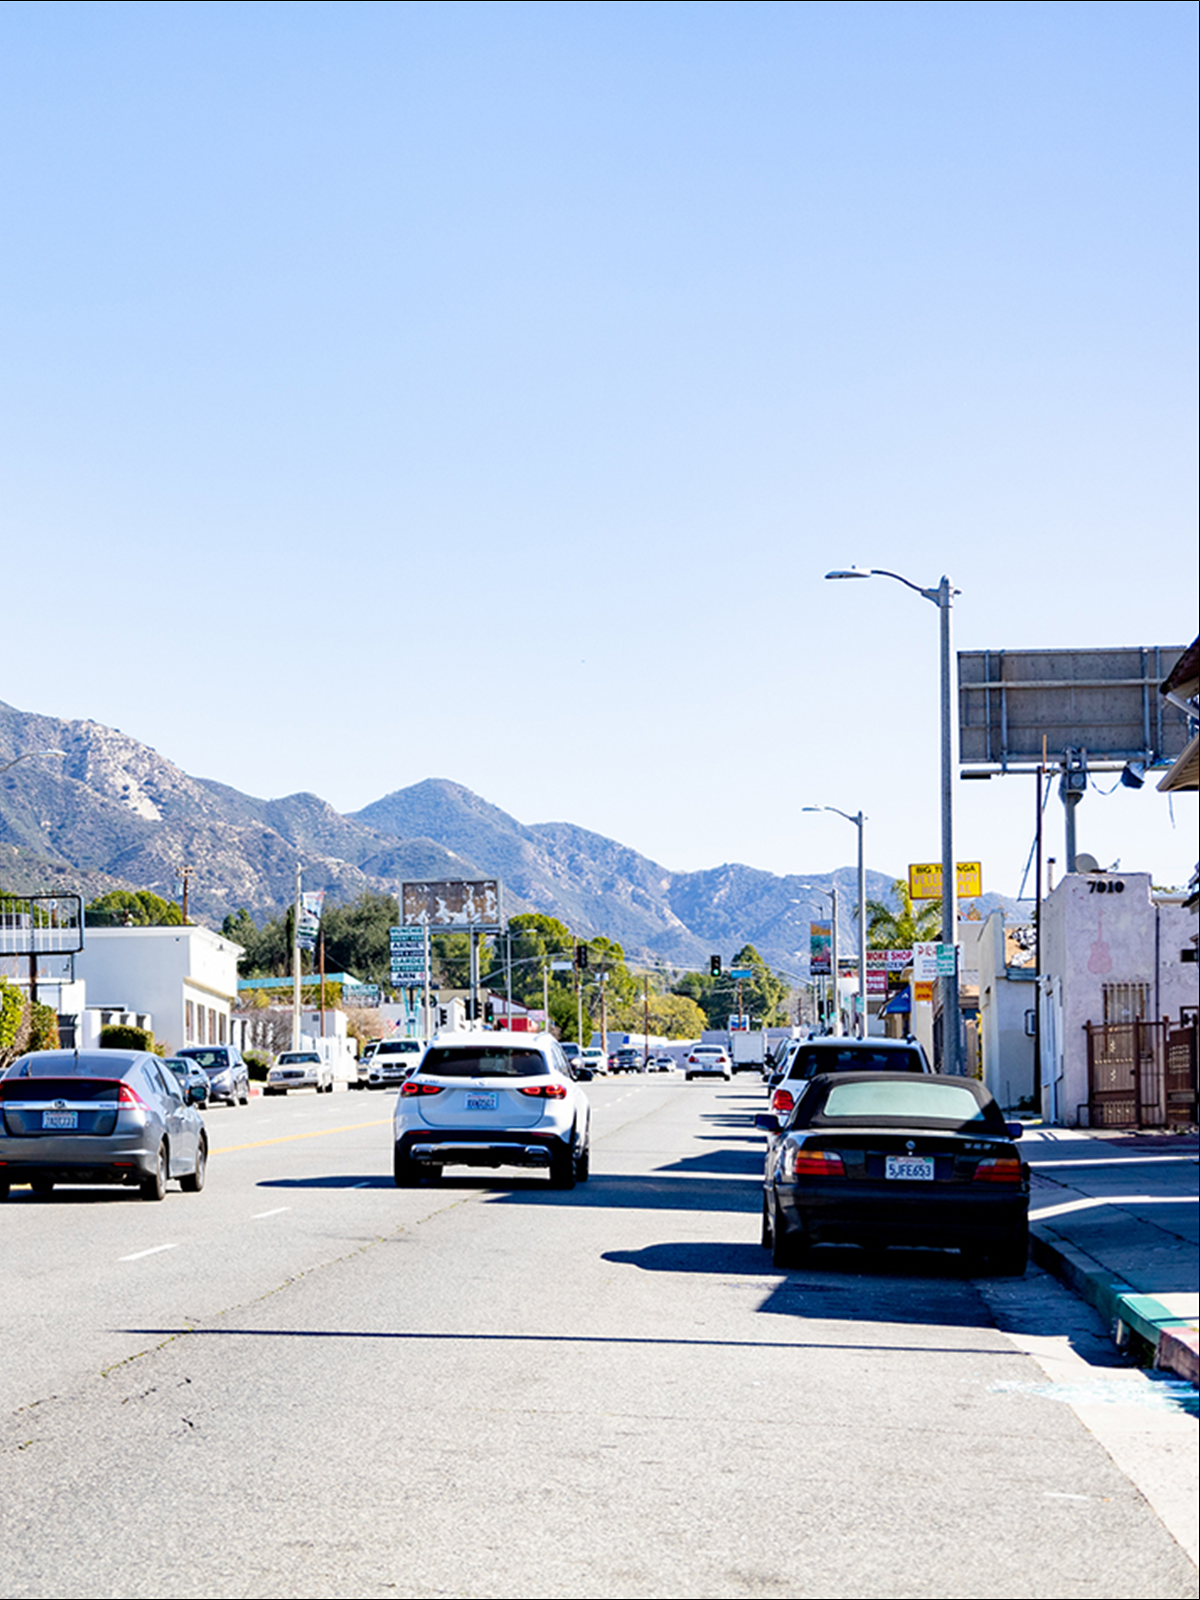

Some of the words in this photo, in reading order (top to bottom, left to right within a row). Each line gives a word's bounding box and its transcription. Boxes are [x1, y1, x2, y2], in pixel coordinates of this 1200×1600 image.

[916, 865, 932, 873] BIG
[935, 864, 976, 873] TNGA
[913, 872, 978, 884] VETEARY
[922, 883, 971, 895] HOSAL
[867, 950, 888, 961] MOKE
[891, 950, 912, 961] SHOP
[867, 961, 904, 969] APORIZER
[888, 1164, 931, 1178] 5JFE653
